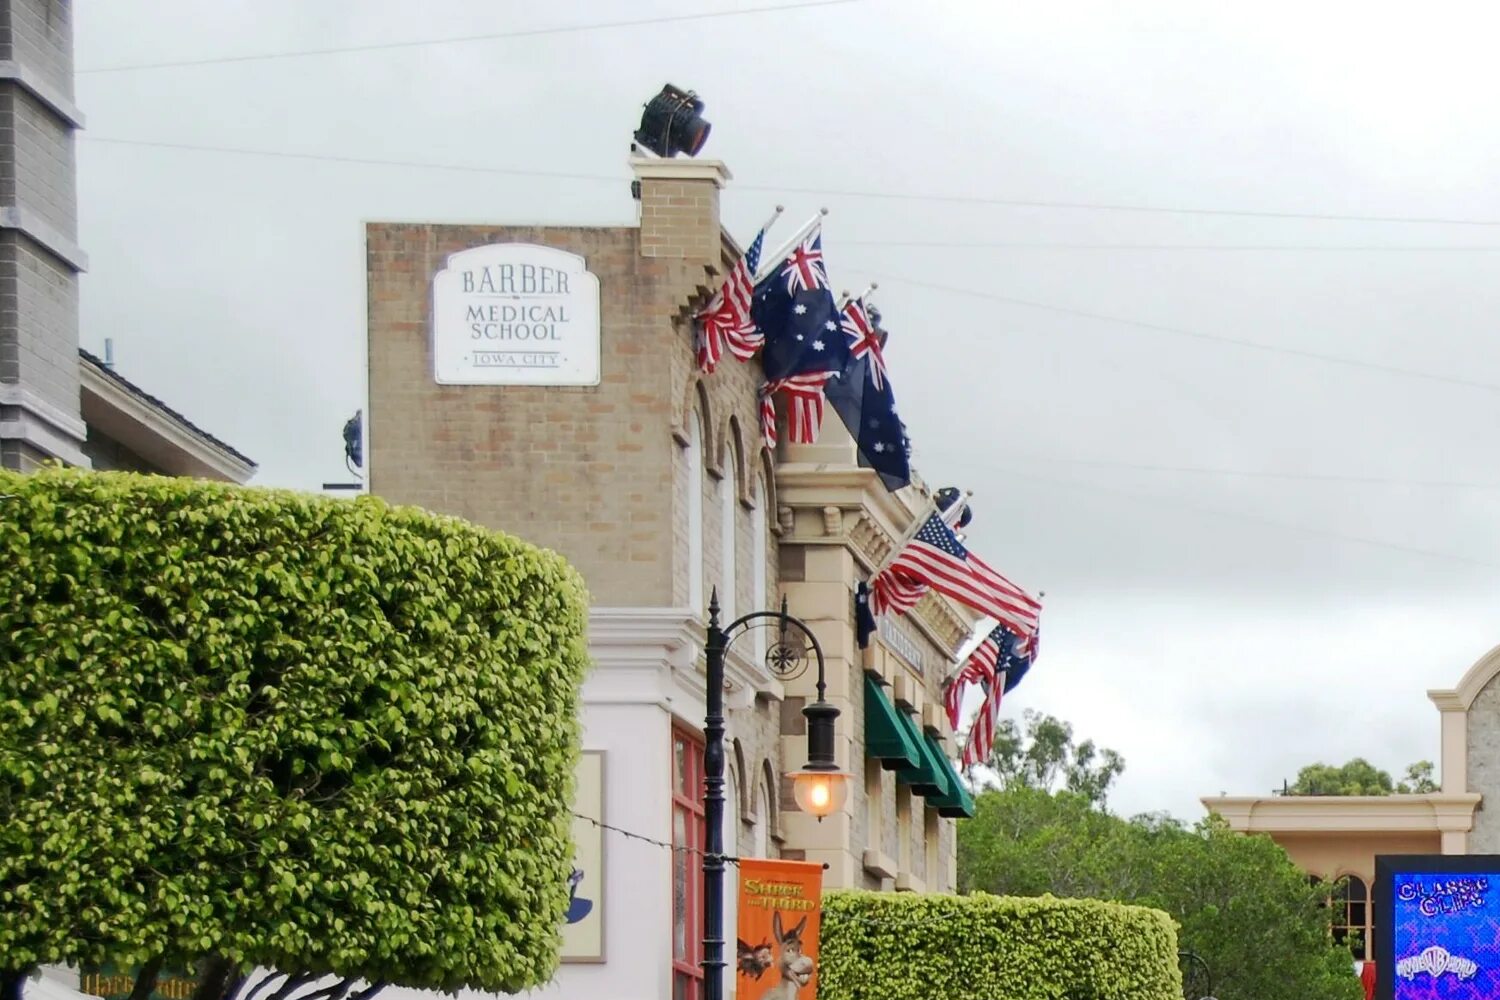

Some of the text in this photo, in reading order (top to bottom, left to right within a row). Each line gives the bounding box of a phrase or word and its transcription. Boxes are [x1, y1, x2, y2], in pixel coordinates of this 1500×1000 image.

[462, 264, 571, 294] BARBER
[466, 305, 570, 322] MEDICAL
[471, 323, 561, 340] SCHOOL
[474, 355, 558, 364] IOWA CITY
[1420, 891, 1485, 916] CLIPS
